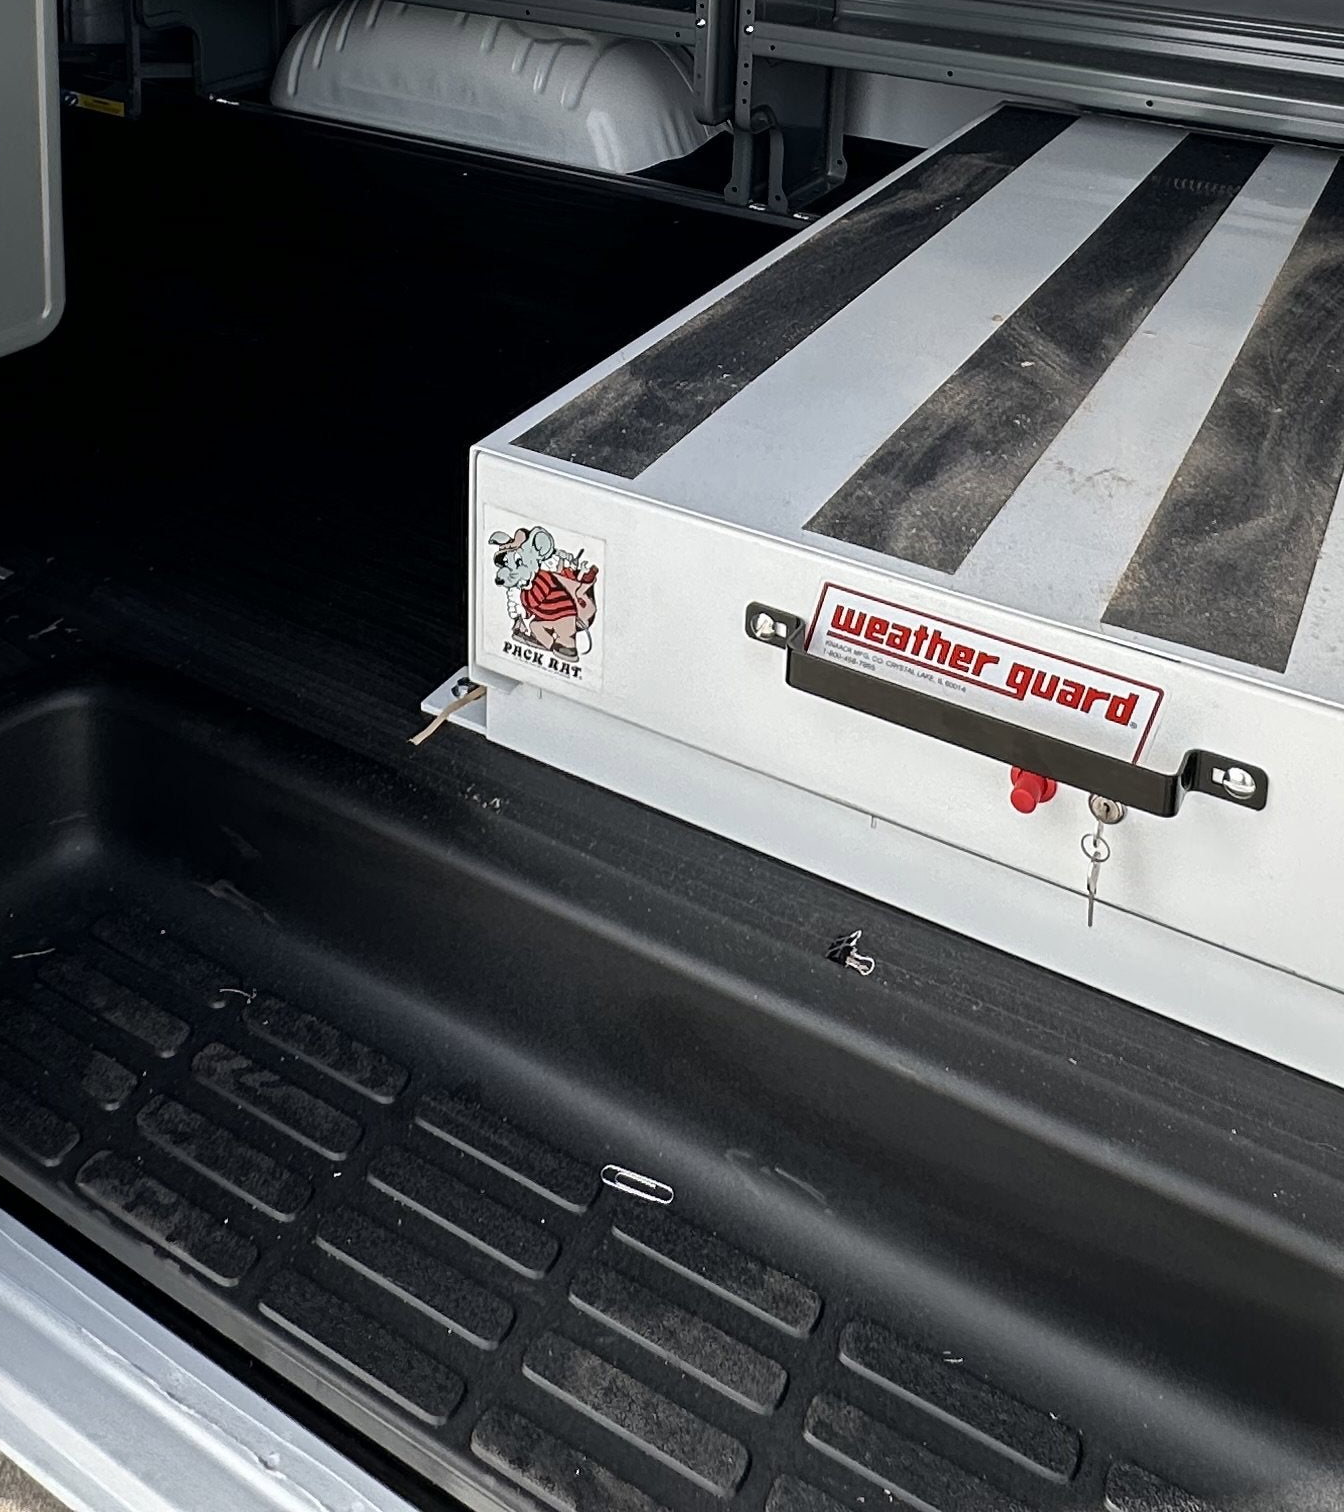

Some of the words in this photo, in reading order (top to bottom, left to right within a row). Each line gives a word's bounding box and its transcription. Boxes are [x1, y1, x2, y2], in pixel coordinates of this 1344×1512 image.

[502, 640, 544, 666] PACK
[830, 604, 1001, 677] weather
[1006, 662, 1140, 726] guard
[885, 659, 916, 676] CRYSTAL
